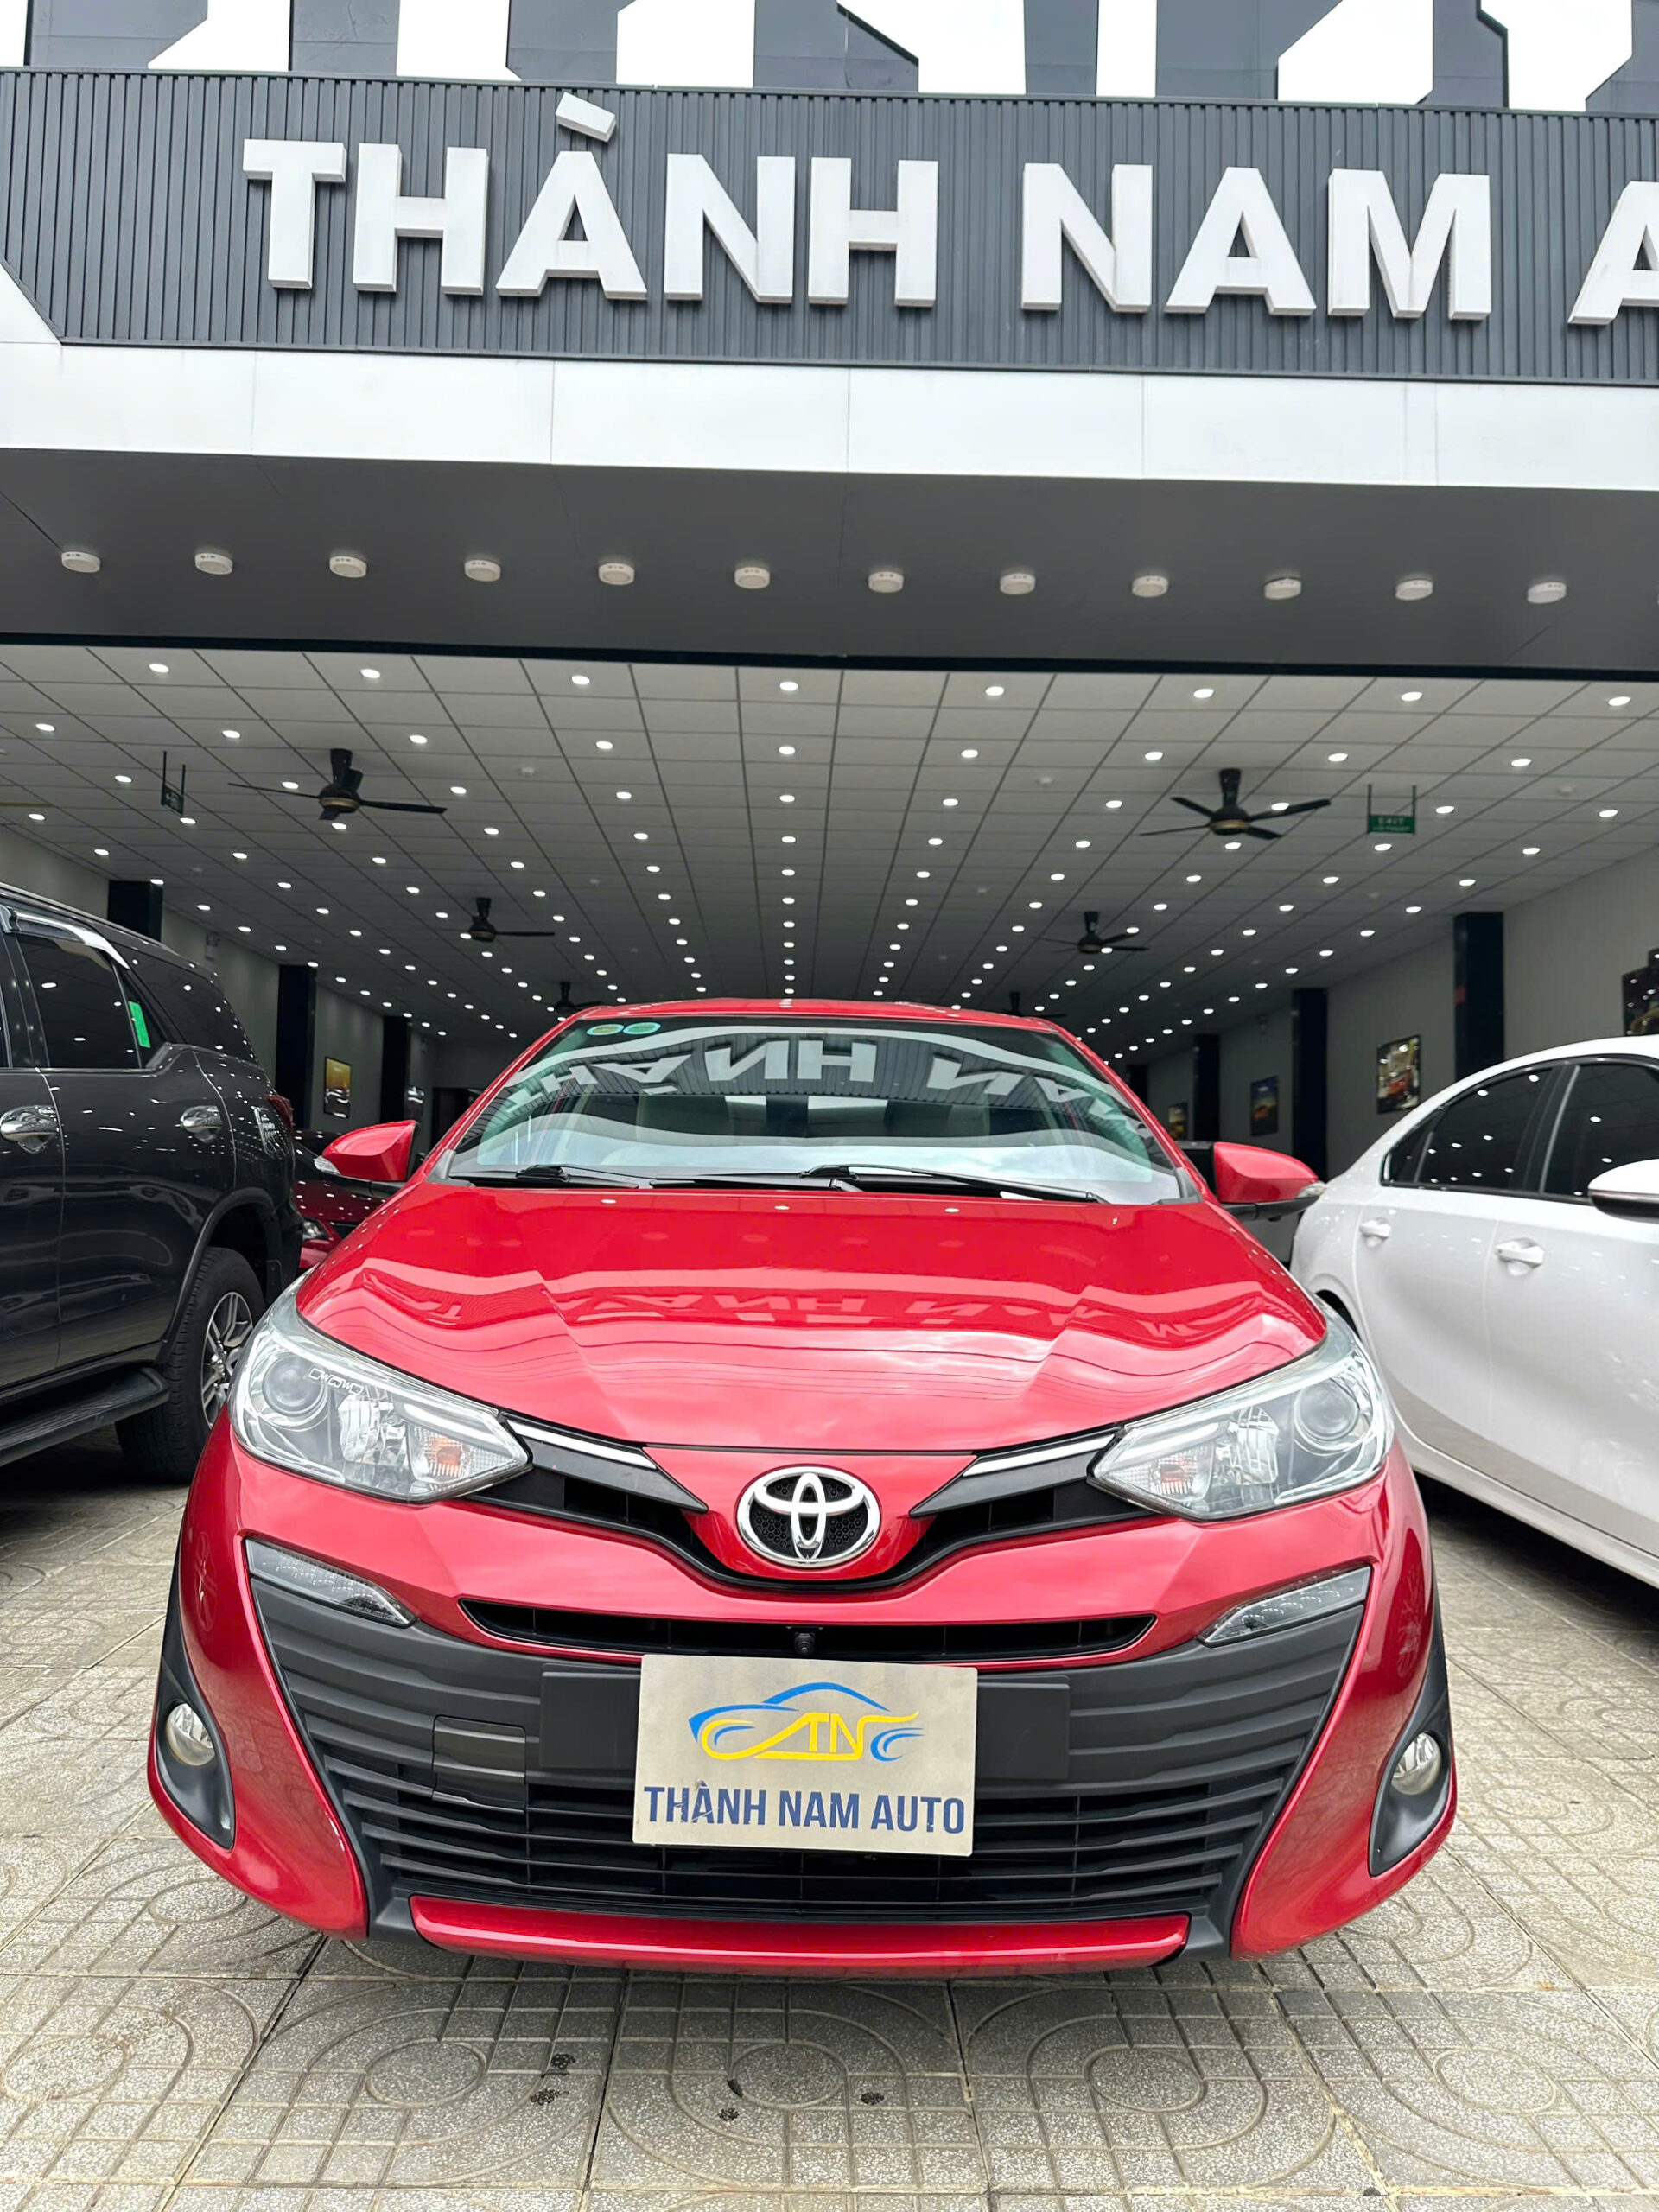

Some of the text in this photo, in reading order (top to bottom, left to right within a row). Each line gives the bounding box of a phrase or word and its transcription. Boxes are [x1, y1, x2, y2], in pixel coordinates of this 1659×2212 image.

[243, 92, 938, 308] THÀNH
[1020, 162, 1491, 321] NAM
[644, 1780, 965, 1834] THÀNH NAM AUTO
